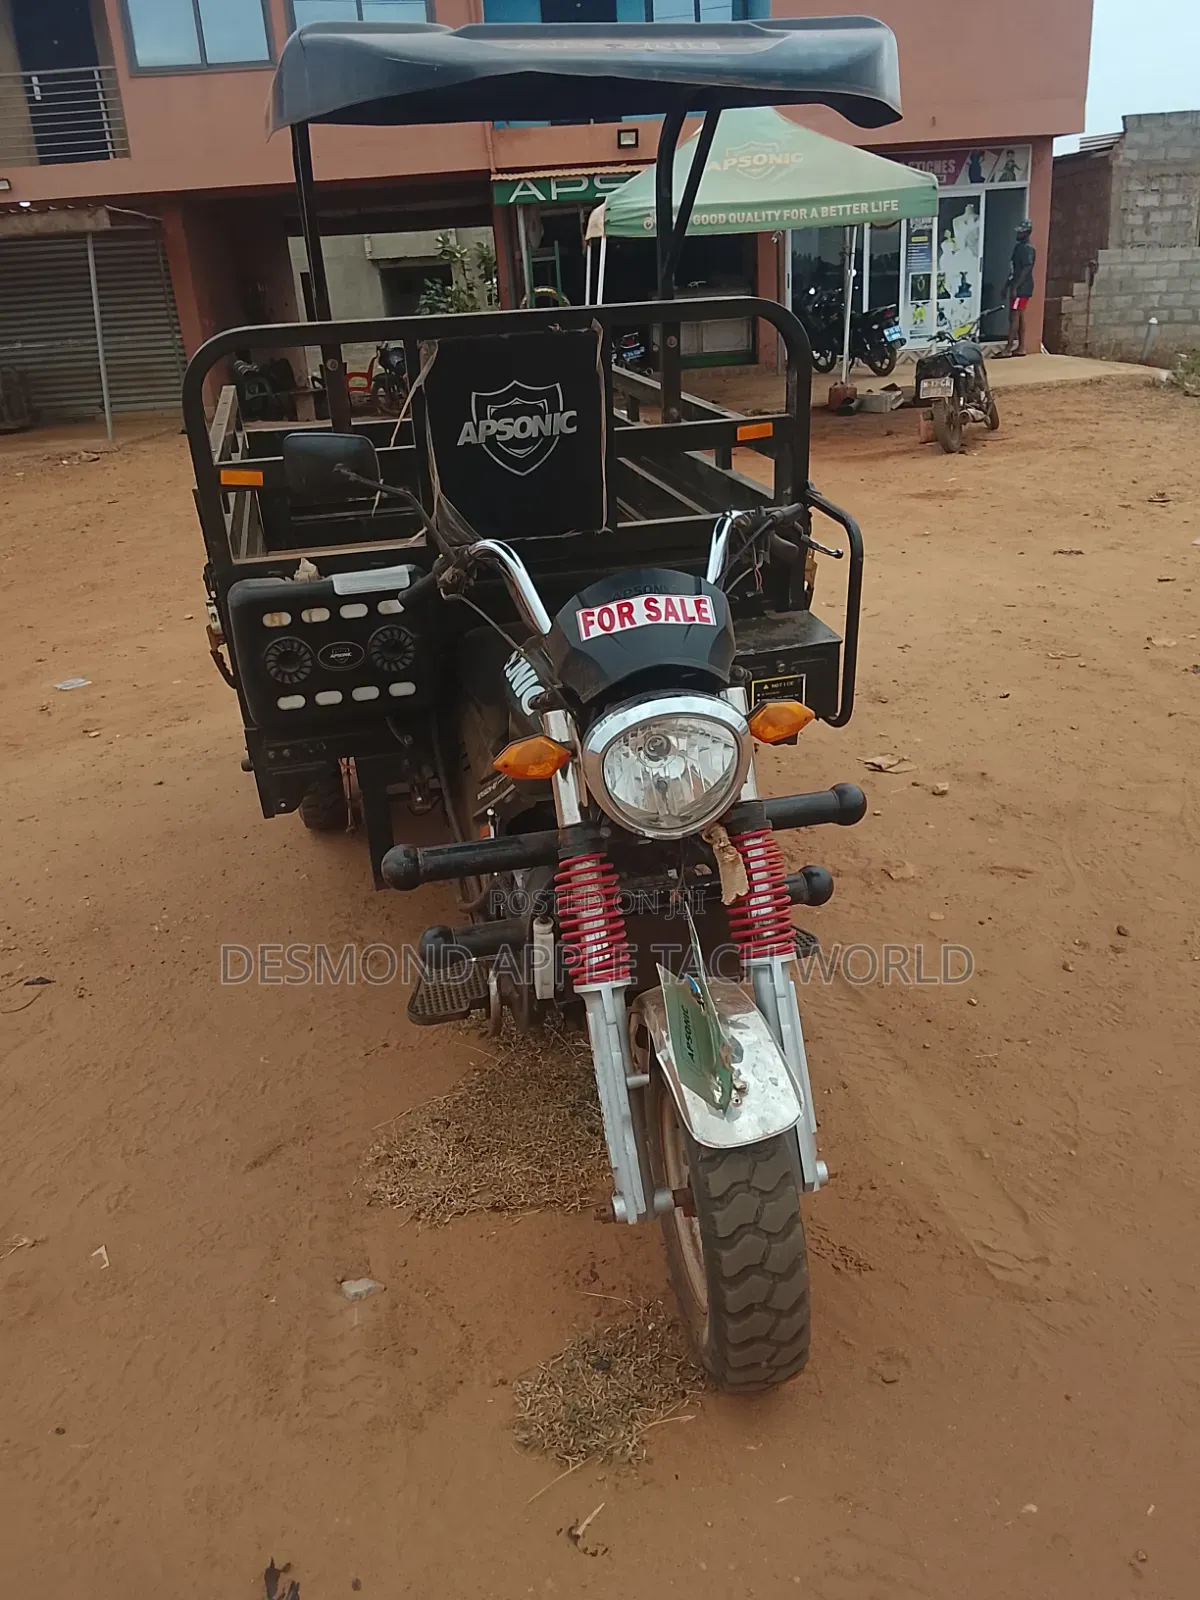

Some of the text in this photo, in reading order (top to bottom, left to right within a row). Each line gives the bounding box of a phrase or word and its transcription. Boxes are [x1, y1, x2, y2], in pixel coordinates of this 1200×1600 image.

[706, 151, 804, 171] APSONIC
[692, 200, 899, 226] GOOD QUALITY FOR A BETTER LIFE
[457, 410, 577, 446] APSONIC
[581, 597, 711, 638] FOR SALE
[681, 1004, 696, 1064] APSONIC
